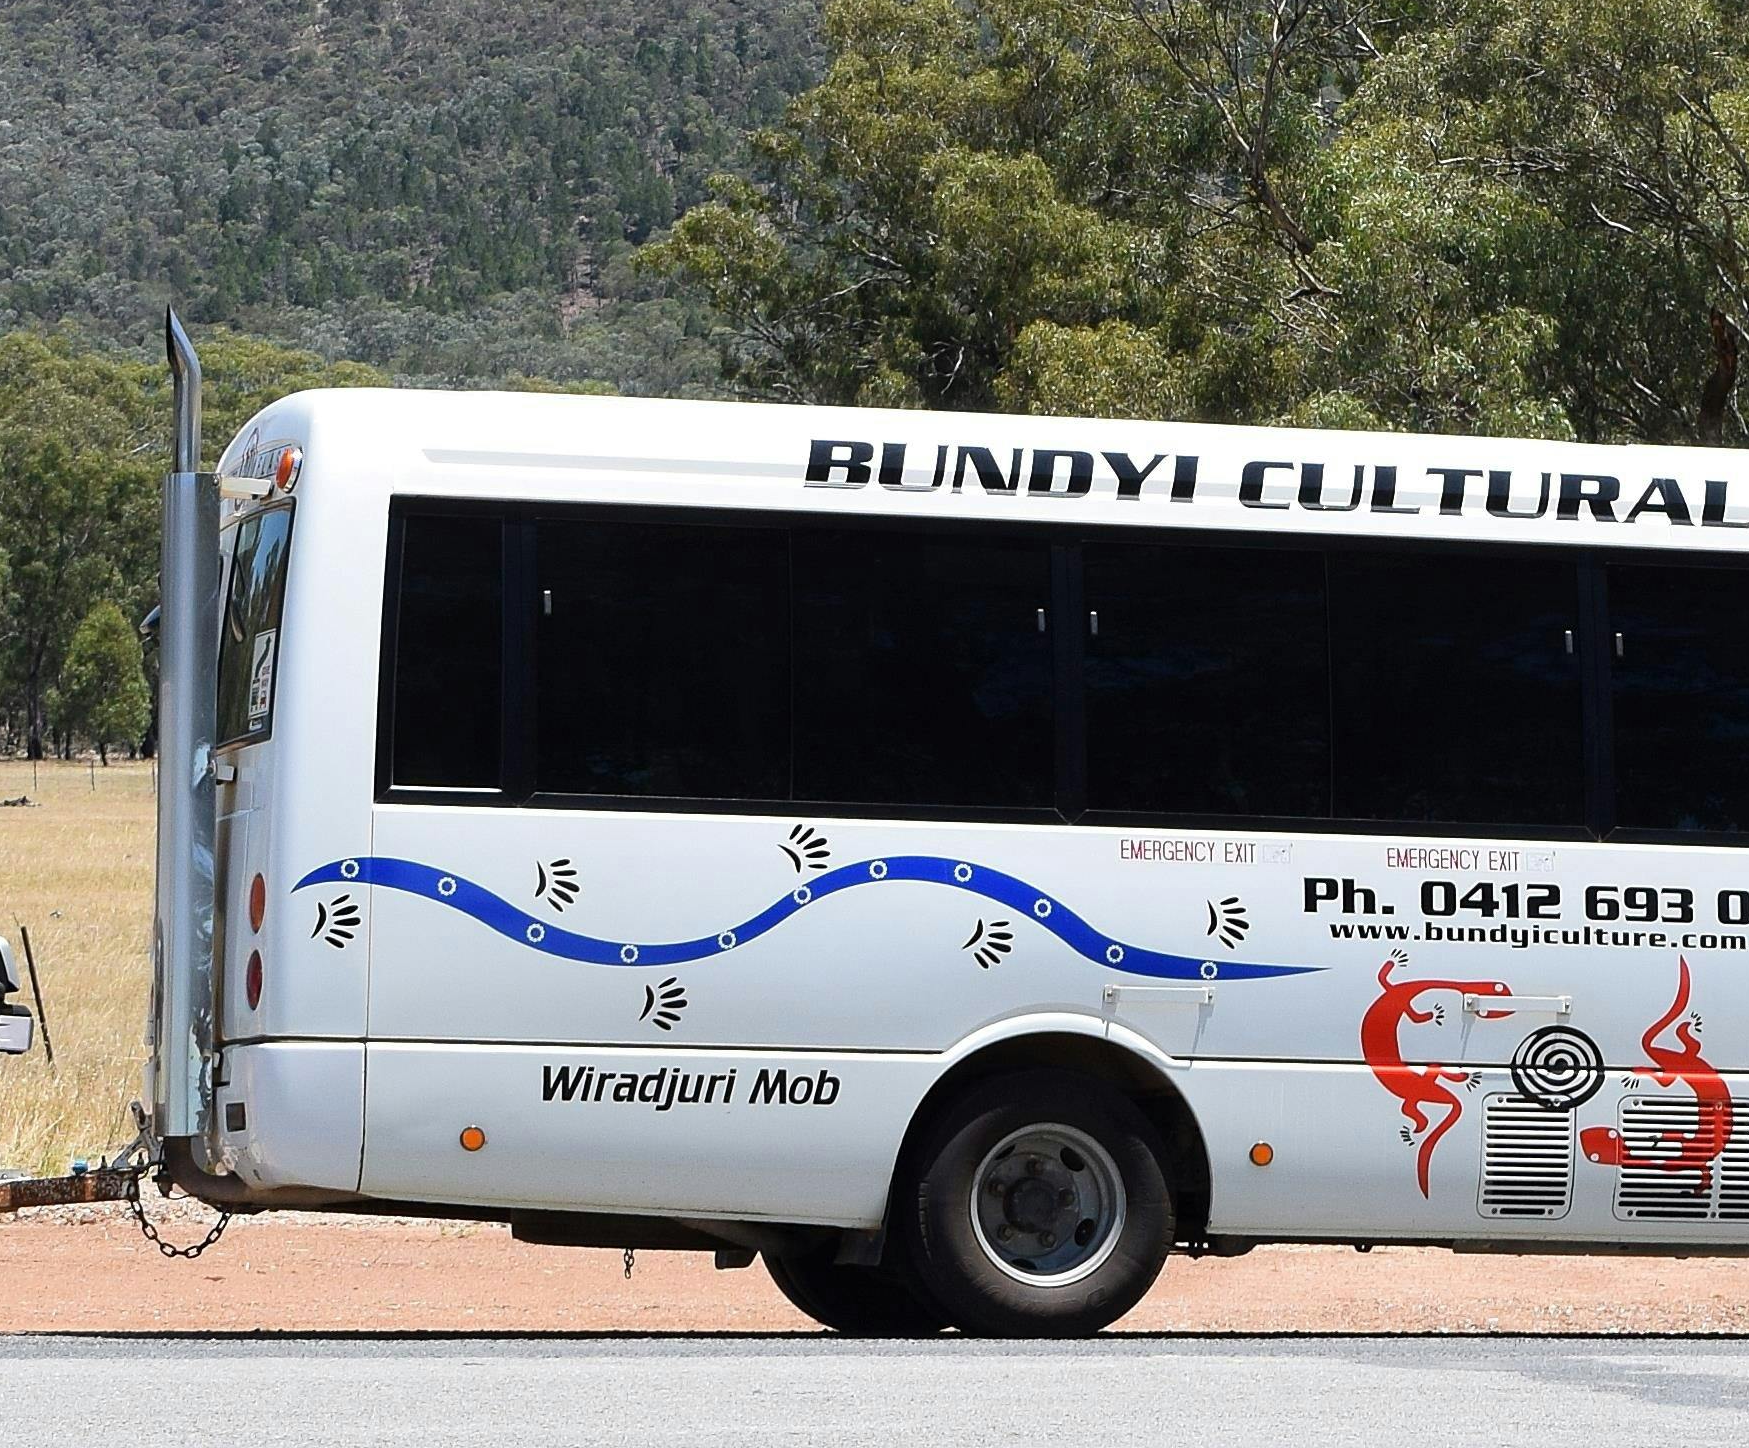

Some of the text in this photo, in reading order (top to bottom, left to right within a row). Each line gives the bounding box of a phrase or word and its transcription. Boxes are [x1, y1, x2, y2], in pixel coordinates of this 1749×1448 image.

[803, 437, 1200, 504] BUNDYI
[1119, 839, 1256, 864] EMERGENCY EXIT
[1386, 847, 1520, 872] EMERGENCY EXIT
[1302, 876, 1396, 916] Ph.
[1419, 880, 1562, 921] 0412
[1583, 884, 1695, 925] 693
[541, 1065, 842, 1111] Wiradjuri Mob
